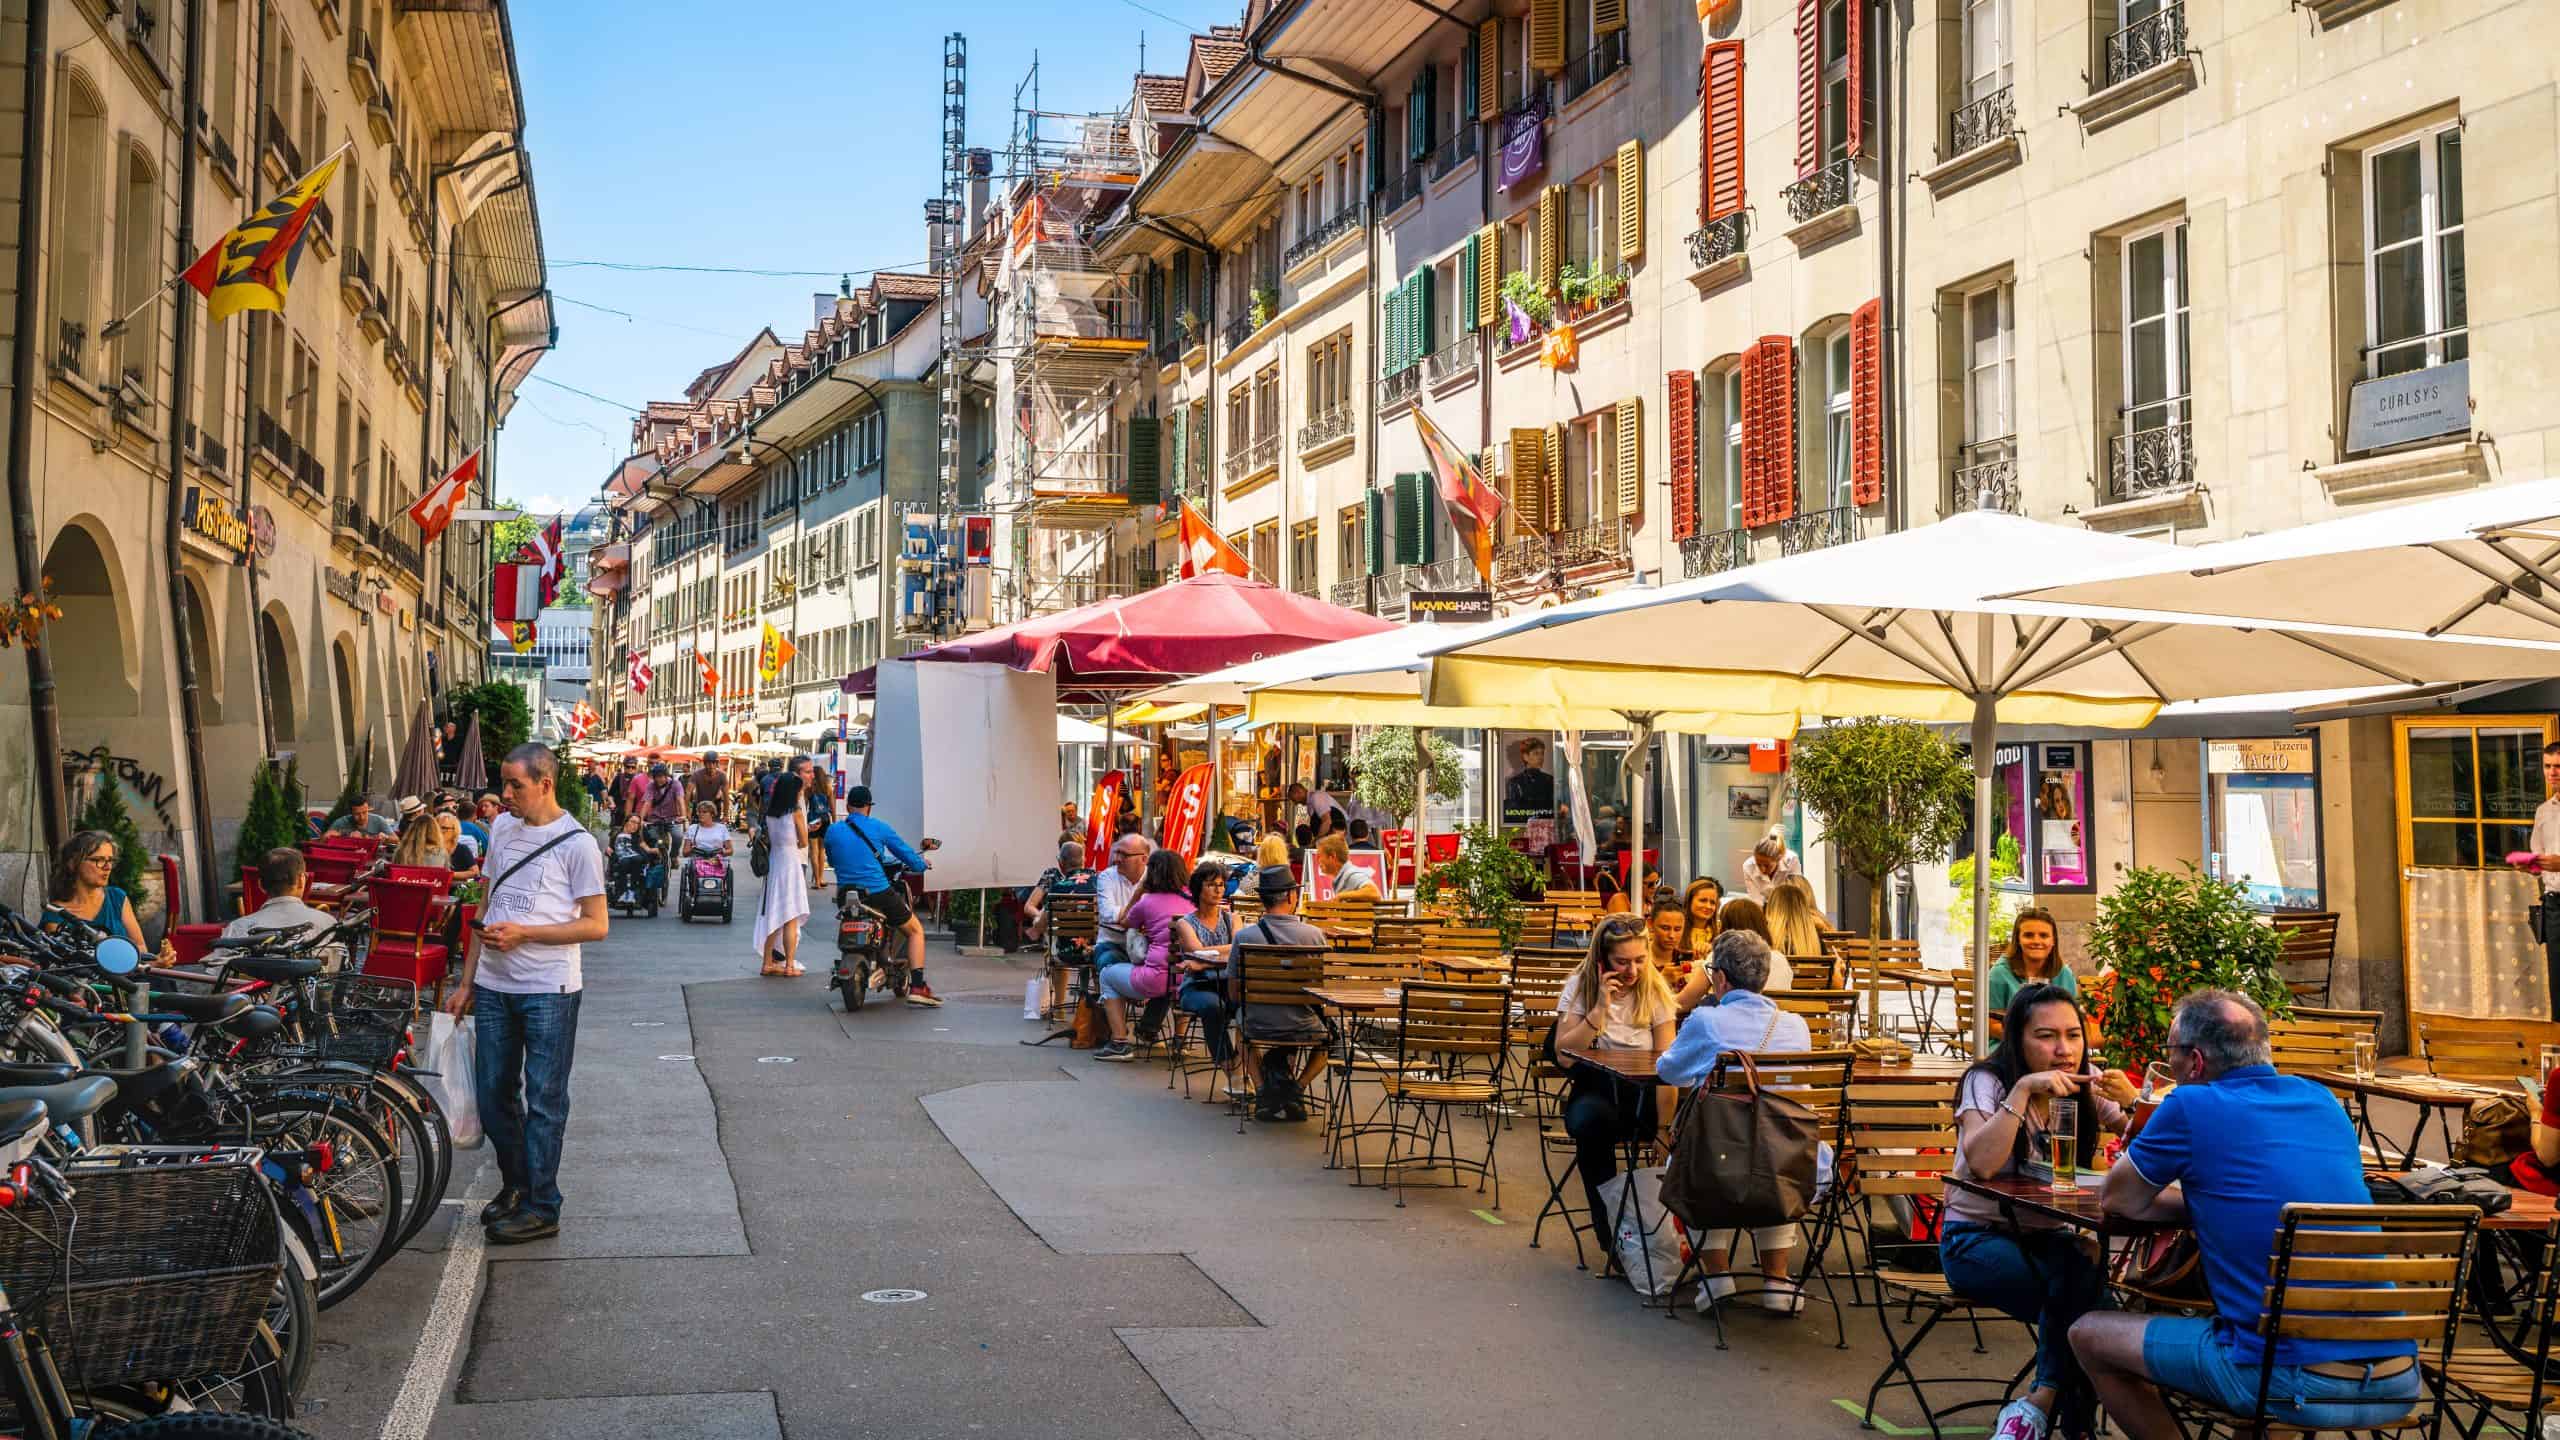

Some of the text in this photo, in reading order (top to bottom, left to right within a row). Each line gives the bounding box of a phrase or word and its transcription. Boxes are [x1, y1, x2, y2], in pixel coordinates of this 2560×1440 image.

[2379, 385, 2440, 412] CURLSYS
[196, 488, 247, 553] PostFinance
[1995, 746, 2021, 766] OOD
[2210, 740, 2309, 752] Ristorante Pizzeria
[2231, 752, 2289, 771] RIALTO
